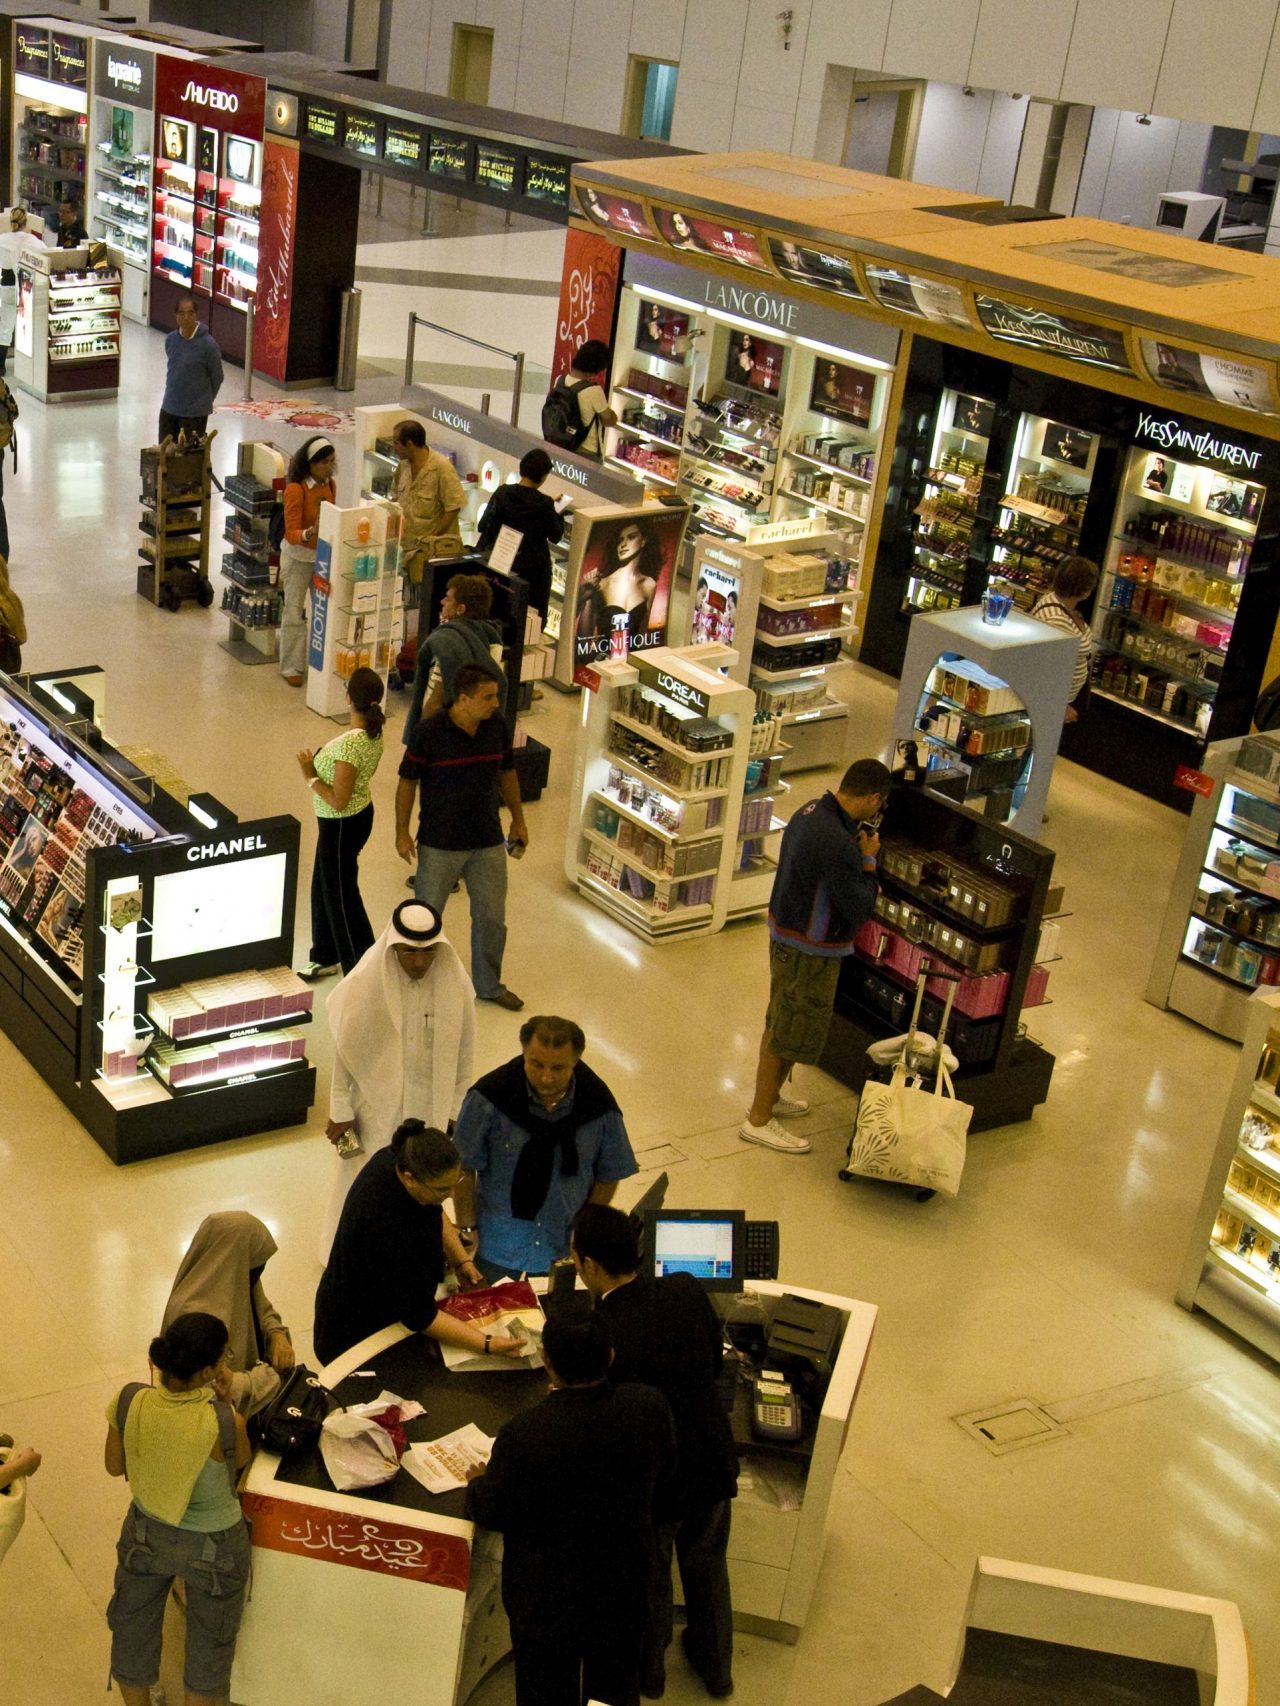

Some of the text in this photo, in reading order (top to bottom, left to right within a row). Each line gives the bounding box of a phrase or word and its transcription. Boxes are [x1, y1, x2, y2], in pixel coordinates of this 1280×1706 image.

[18, 36, 50, 59] Fragrances
[54, 43, 86, 68] Fragrances
[181, 81, 238, 113] SHISEIDO
[704, 280, 800, 329] LANCÔME
[432, 407, 472, 434] LANCÔME
[761, 522, 813, 541] cacharel
[704, 568, 736, 587] cacharel
[311, 561, 329, 652] BIOTHEM
[577, 631, 661, 656] MAGNIFIQUE
[657, 672, 705, 708] L'ORÉAL
[187, 835, 267, 861] CHANEL
[229, 1027, 259, 1039] CHANEL
[227, 1073, 257, 1085] CHANEL
